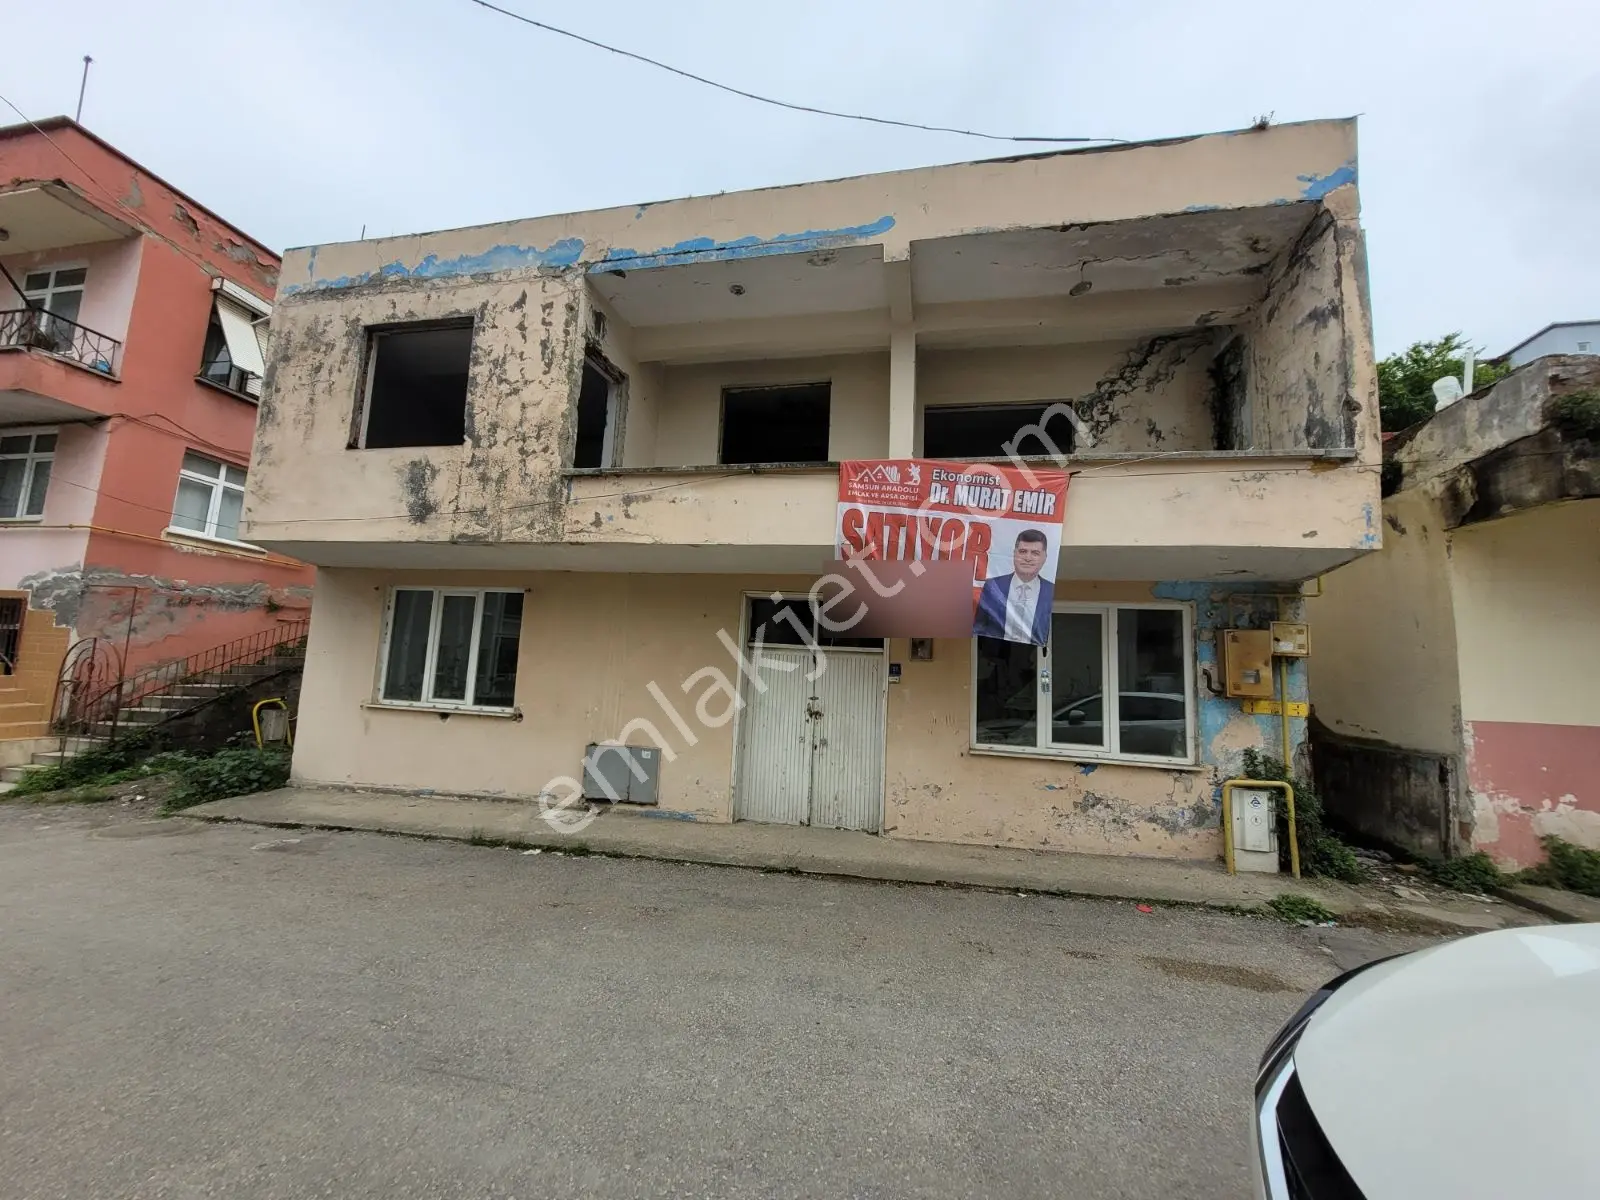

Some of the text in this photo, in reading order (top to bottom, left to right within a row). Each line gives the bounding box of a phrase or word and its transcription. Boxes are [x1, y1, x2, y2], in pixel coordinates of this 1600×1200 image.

[932, 469, 1001, 486] Ekonomist
[848, 482, 919, 494] SAMSUN ANADOLU
[848, 490, 870, 498] EMLAK
[930, 482, 1056, 515] Dr. MURAT EMİR
[842, 508, 992, 581] SATIYOR
